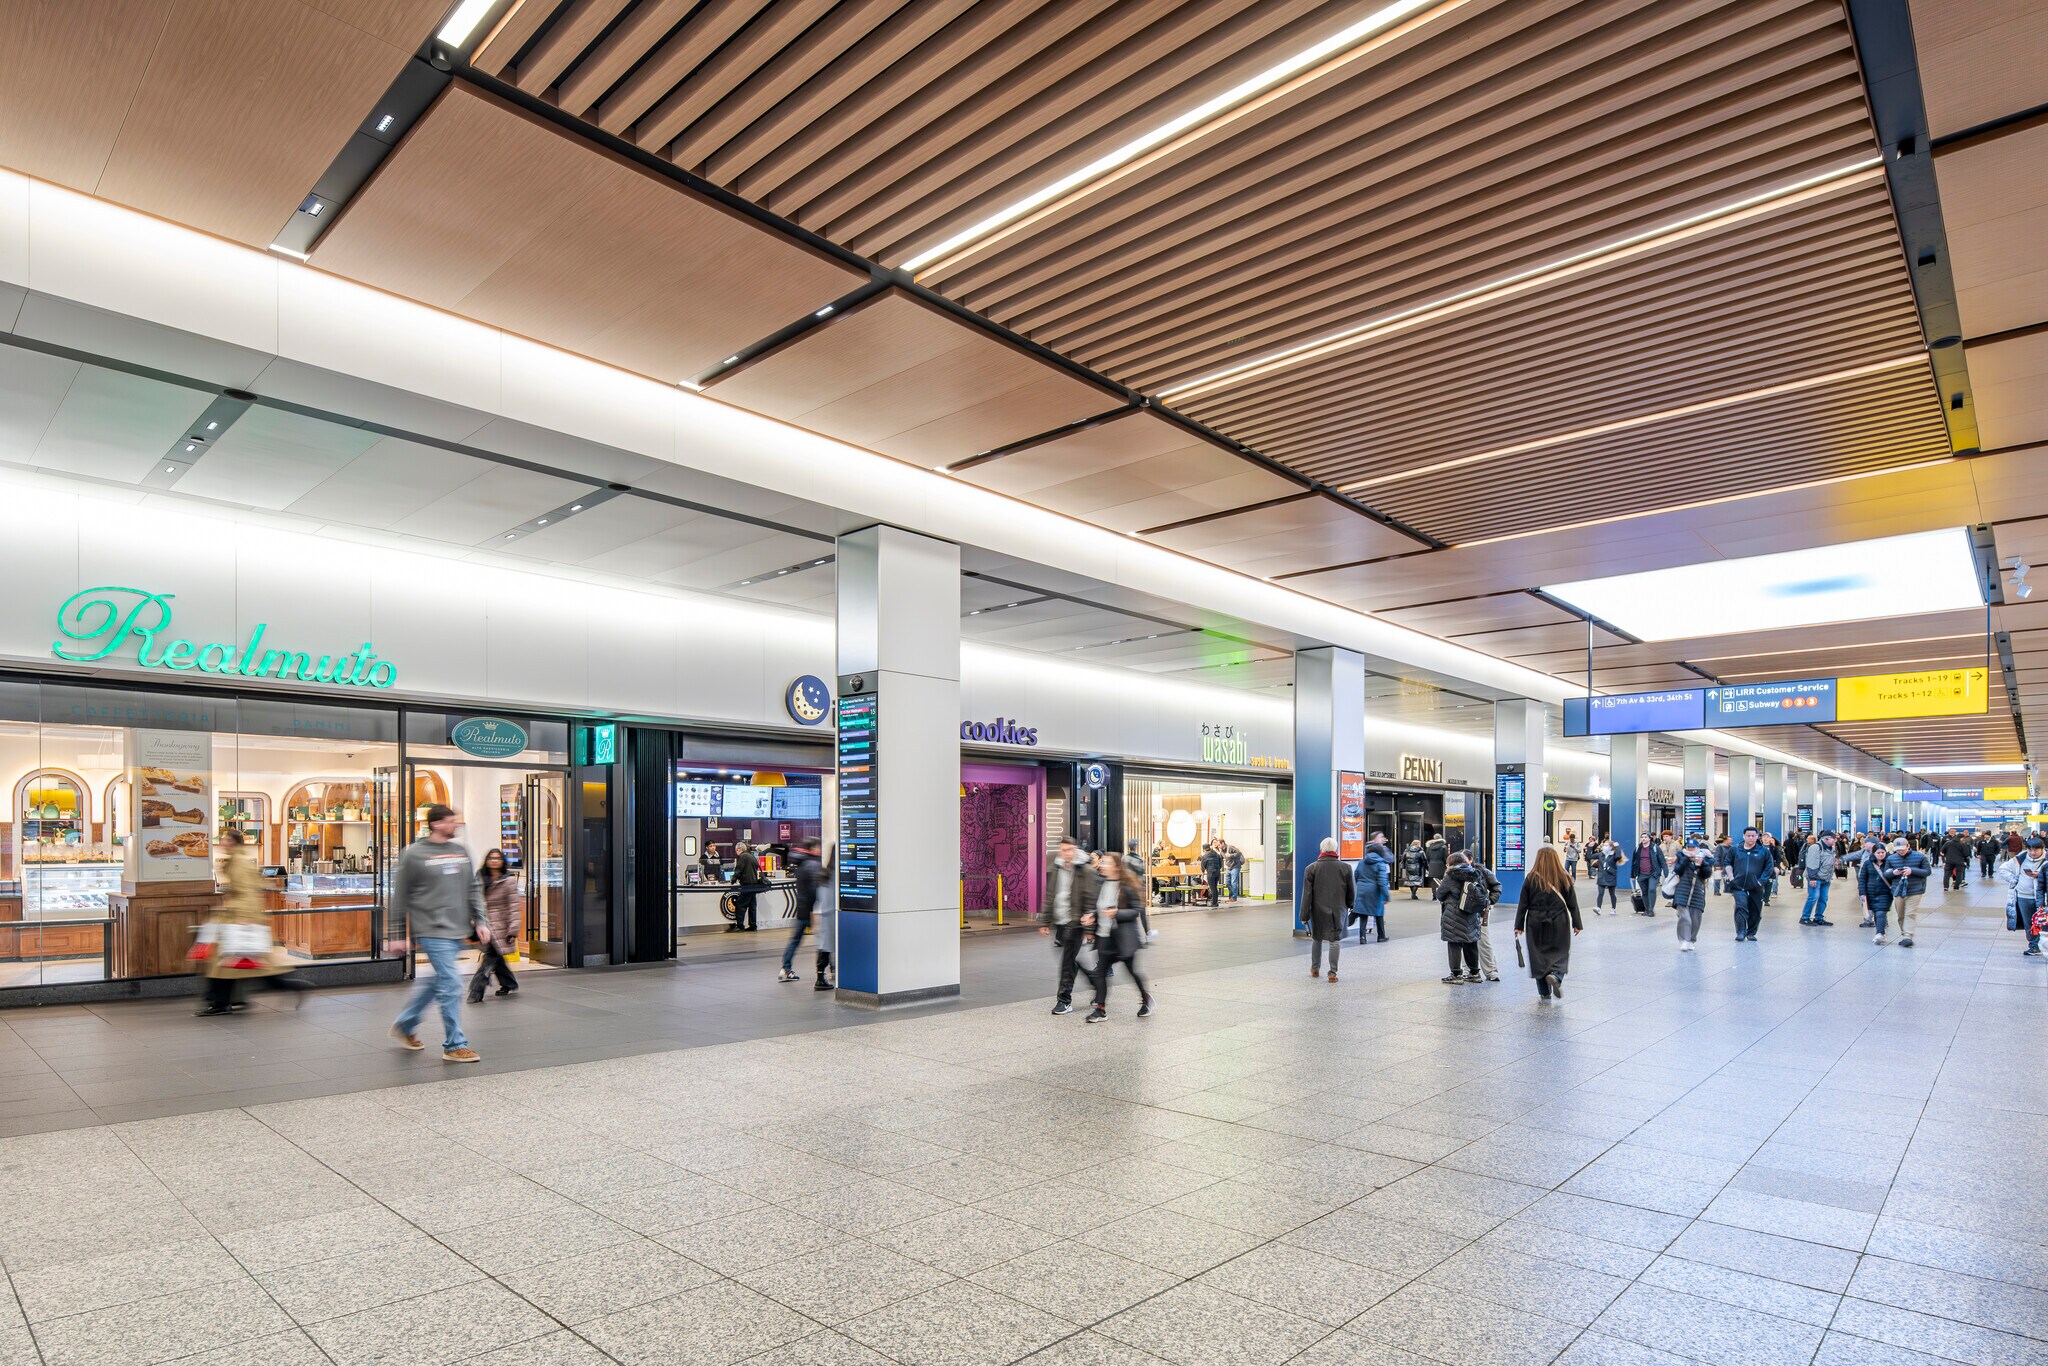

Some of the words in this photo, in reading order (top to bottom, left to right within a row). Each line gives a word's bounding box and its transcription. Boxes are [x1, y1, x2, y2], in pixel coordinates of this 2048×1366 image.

[52, 586, 397, 688] Realmuto
[1893, 677, 1924, 685] Tracks
[1735, 688, 1755, 697] LIRR
[1756, 685, 1797, 695] Customer
[1797, 683, 1829, 692] Service
[1616, 697, 1628, 705] 7th
[1646, 695, 1665, 704] 33rd,
[1666, 694, 1683, 702] 34th
[1684, 693, 1693, 701] St
[1749, 700, 1780, 709] Subway
[460, 726, 522, 745] Realmuto
[961, 717, 1038, 746] cookies
[1202, 722, 1234, 739] わさび
[1203, 732, 1247, 766] wasabi
[1404, 756, 1436, 783] PENN
[1437, 761, 1443, 783] 1
[709, 816, 716, 824] A
